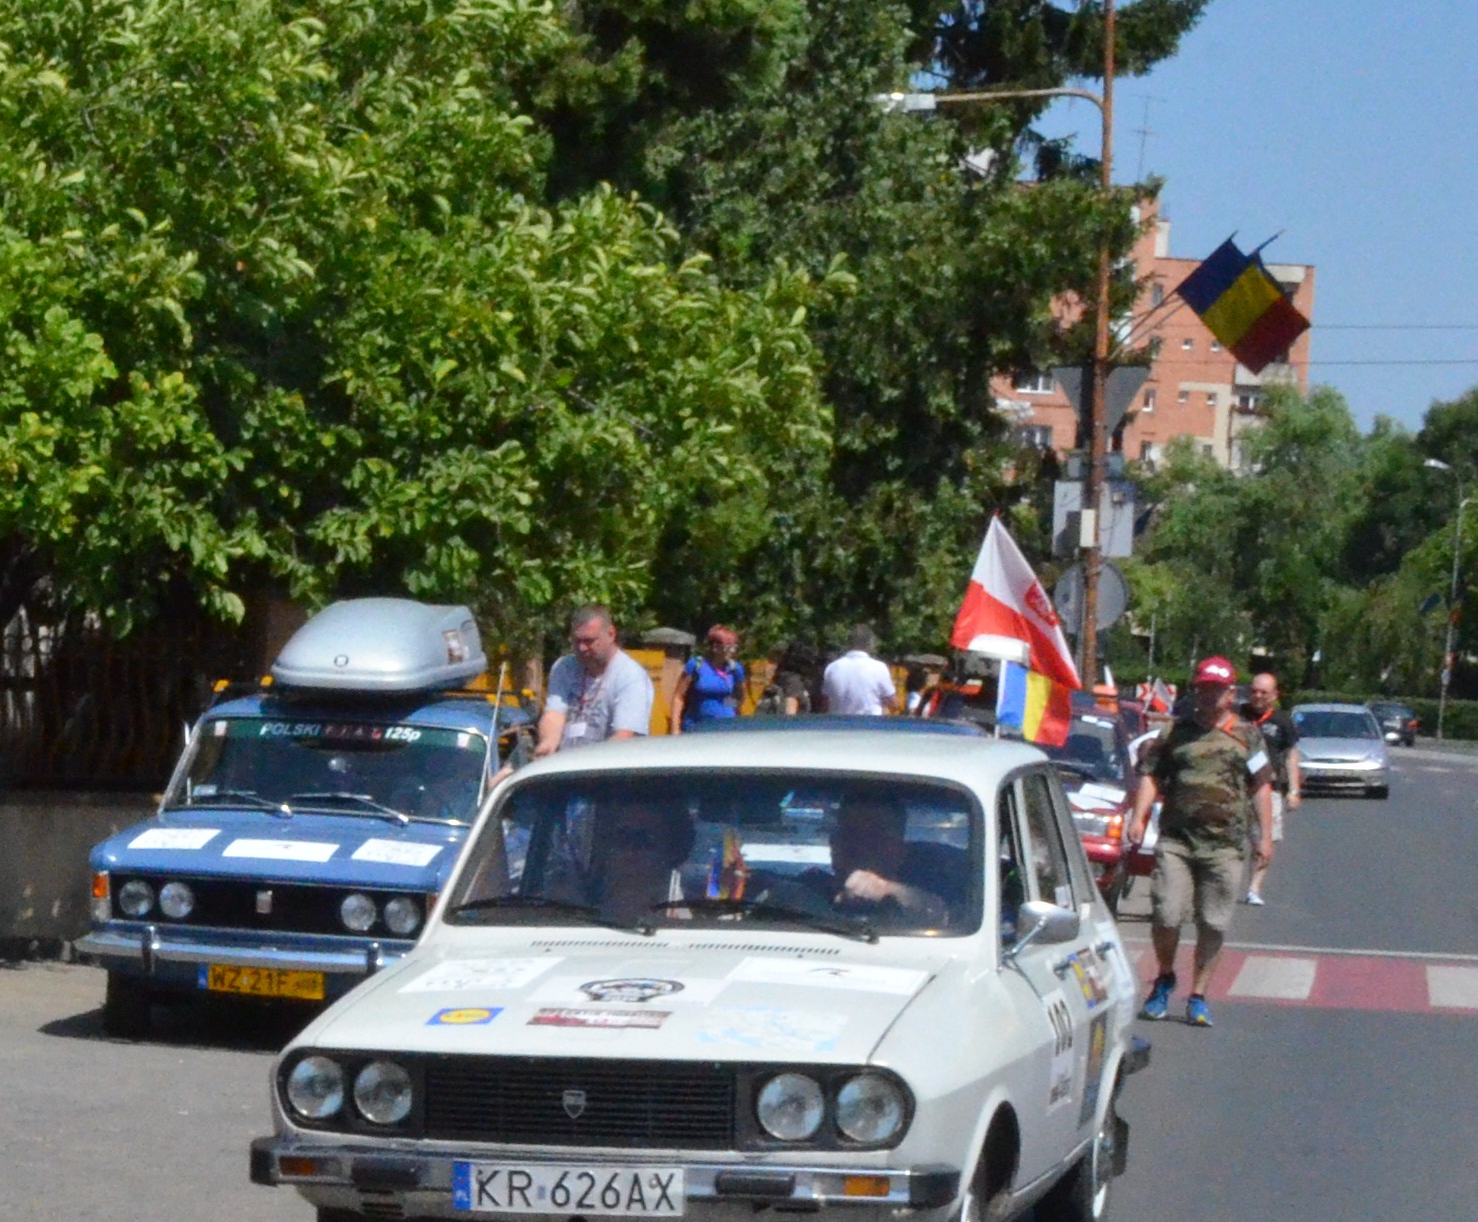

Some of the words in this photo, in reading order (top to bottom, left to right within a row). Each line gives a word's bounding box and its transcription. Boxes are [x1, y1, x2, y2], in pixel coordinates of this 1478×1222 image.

[260, 723, 321, 736] POLSKI
[385, 726, 422, 742] 125p
[211, 966, 243, 991] WZ
[249, 970, 289, 994] 21F
[477, 1169, 533, 1208] KR
[550, 1170, 676, 1212] 626AX
